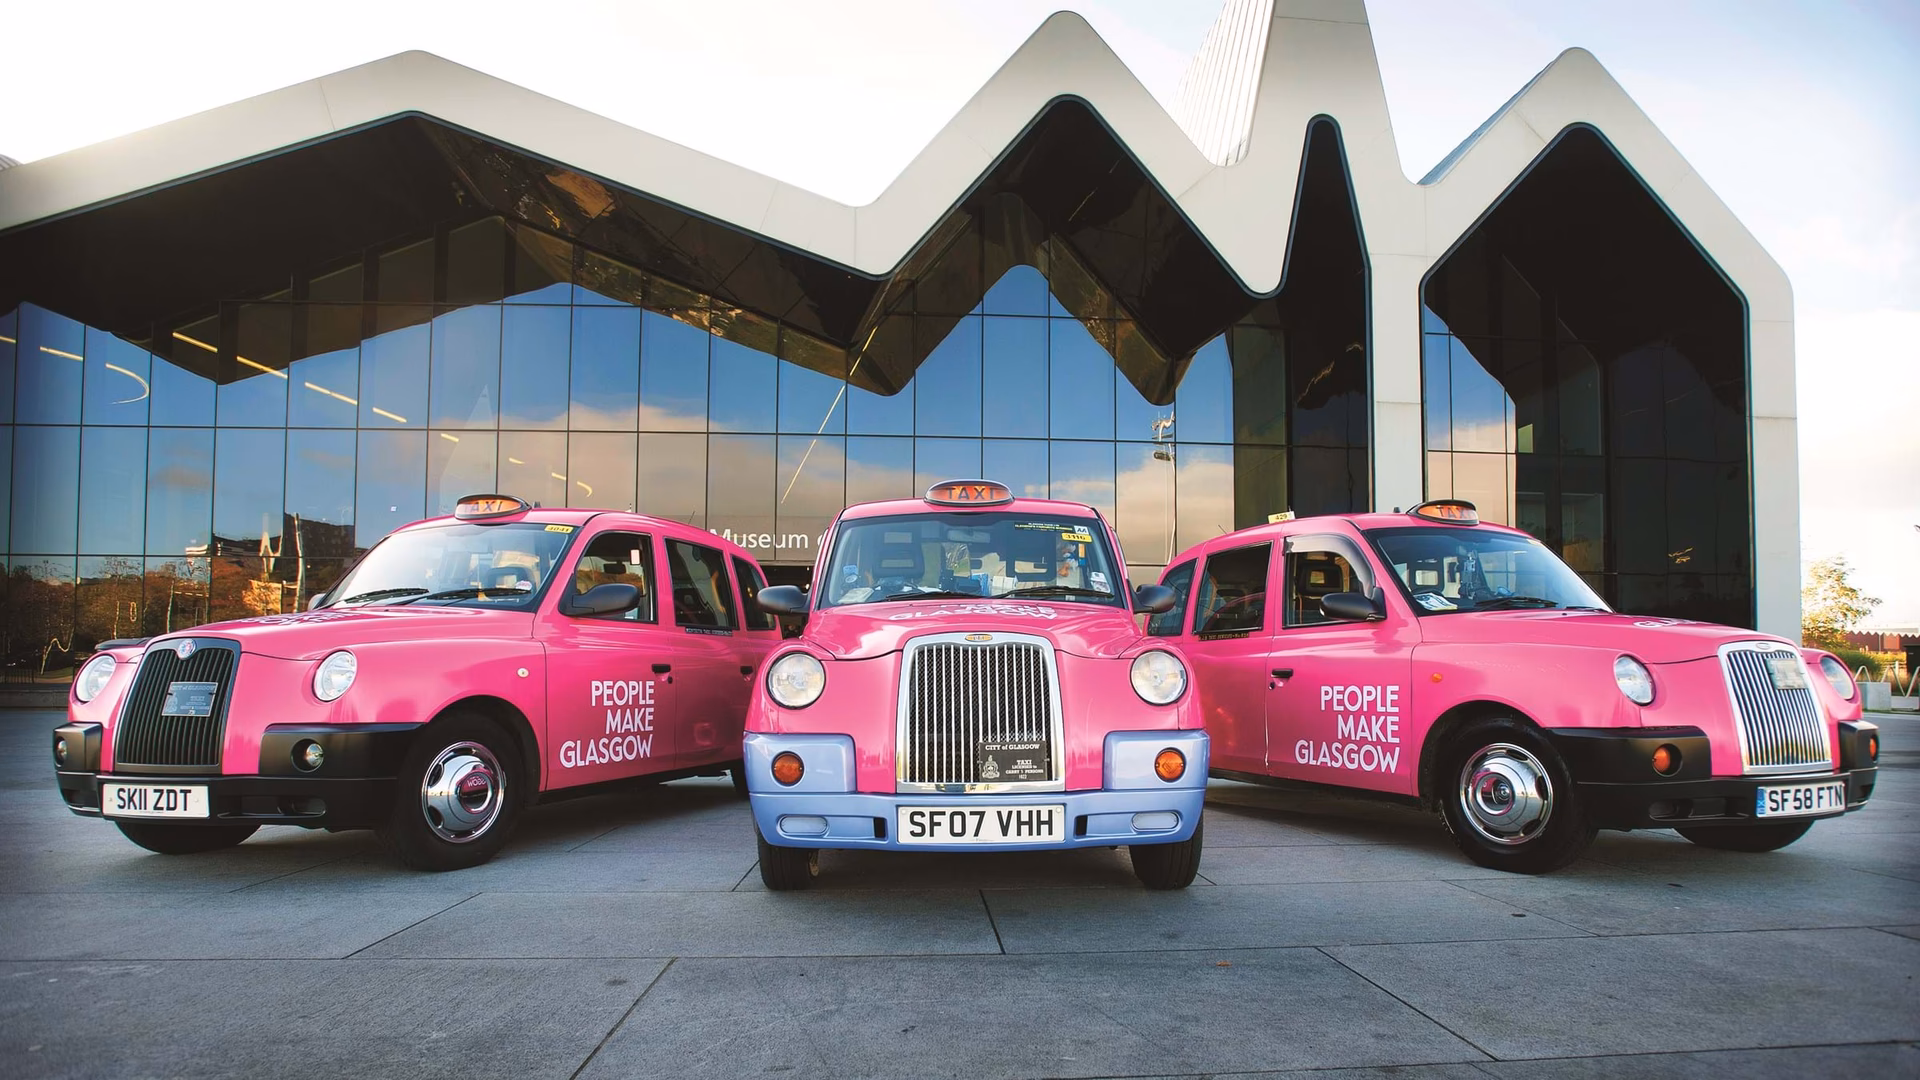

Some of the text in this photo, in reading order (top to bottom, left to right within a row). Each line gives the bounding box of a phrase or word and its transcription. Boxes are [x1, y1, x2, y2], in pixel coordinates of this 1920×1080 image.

[947, 487, 994, 499] TAXI
[1436, 507, 1473, 519] TAX
[888, 609, 1058, 621] GLASGOW
[591, 680, 655, 706] PEOPLE
[1320, 685, 1400, 713] PEOPLE
[605, 707, 655, 734] MAKE
[1337, 714, 1400, 743] MAKE
[559, 734, 653, 768] GLASGOW
[1295, 739, 1400, 774] GLASGOW
[117, 788, 192, 811] SK11 ZDT
[1769, 784, 1843, 812] SF58 FTN
[909, 809, 1053, 837] SF07 VHH
